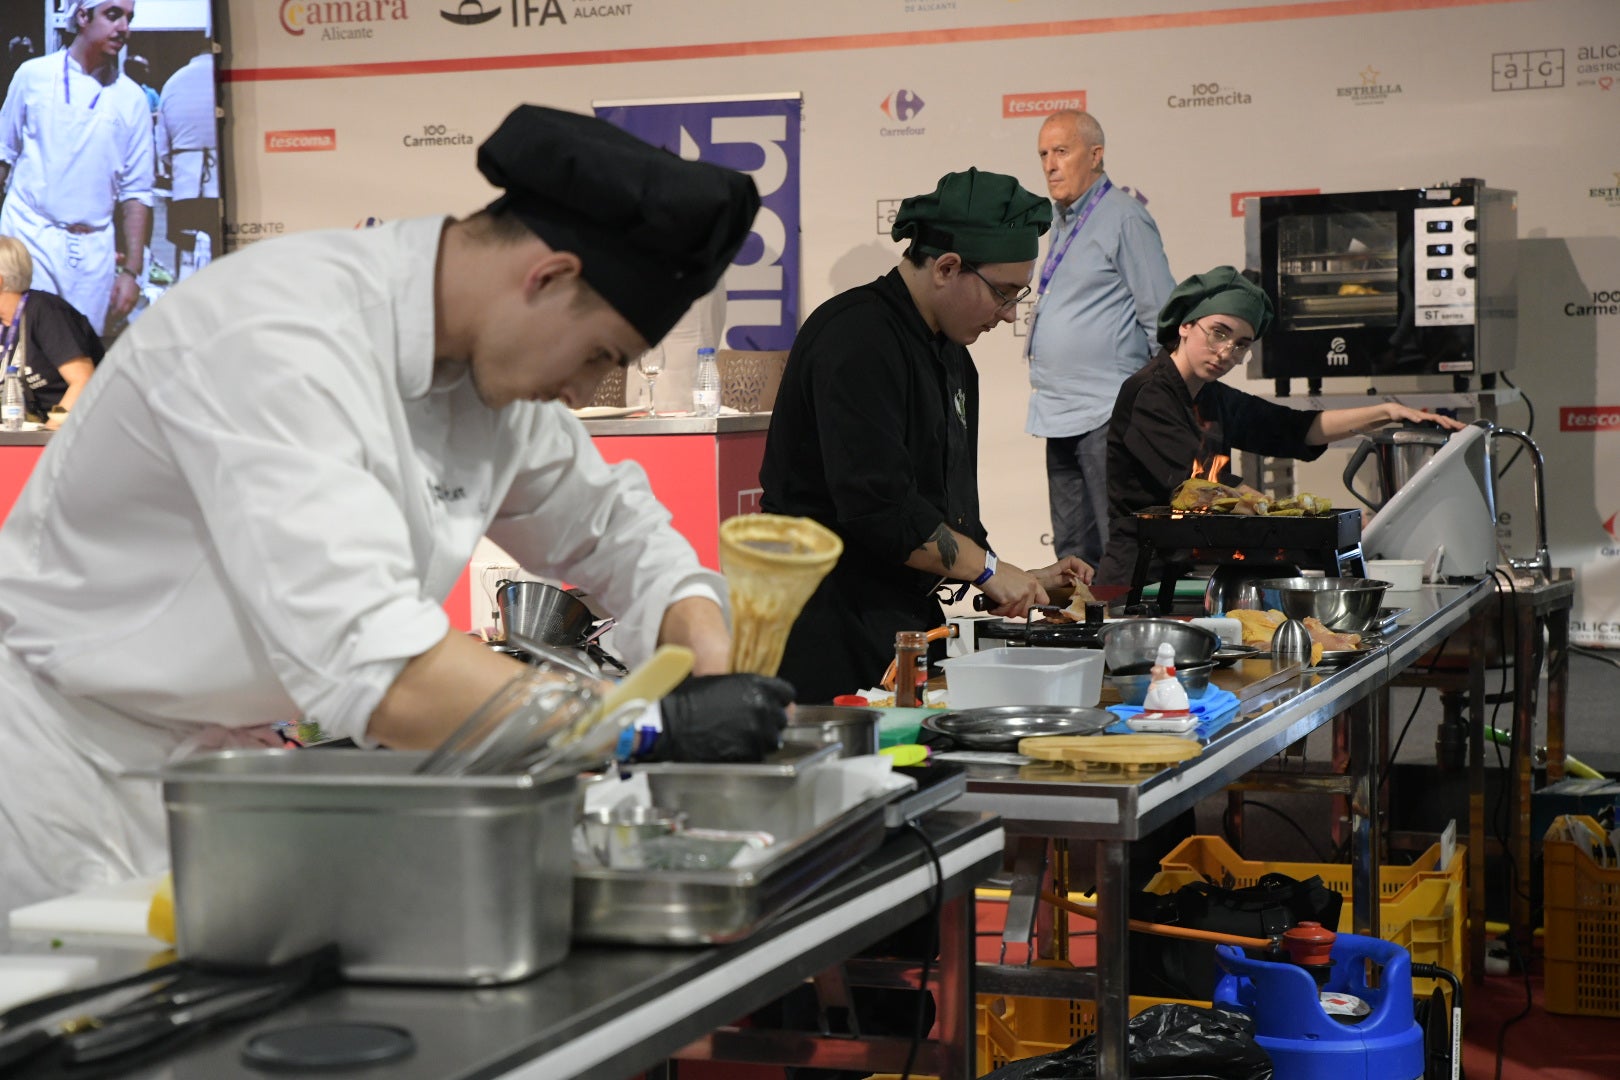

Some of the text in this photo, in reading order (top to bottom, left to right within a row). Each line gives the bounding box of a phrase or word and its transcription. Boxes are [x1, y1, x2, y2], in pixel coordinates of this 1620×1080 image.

[511, 0, 567, 27] IFA
[574, 4, 632, 18] ALACANT
[321, 26, 373, 41] Alicante
[1192, 82, 1219, 96] 100
[1336, 84, 1402, 97] ESTRELLA
[1008, 99, 1081, 113] tescoma
[1167, 91, 1252, 108] Carmencita
[423, 124, 447, 136] 100
[880, 126, 925, 137] Carrefour
[270, 135, 331, 149] tescoma
[403, 133, 474, 147] Carmencita
[1424, 310, 1439, 321] ST
[1564, 302, 1620, 317] Carme
